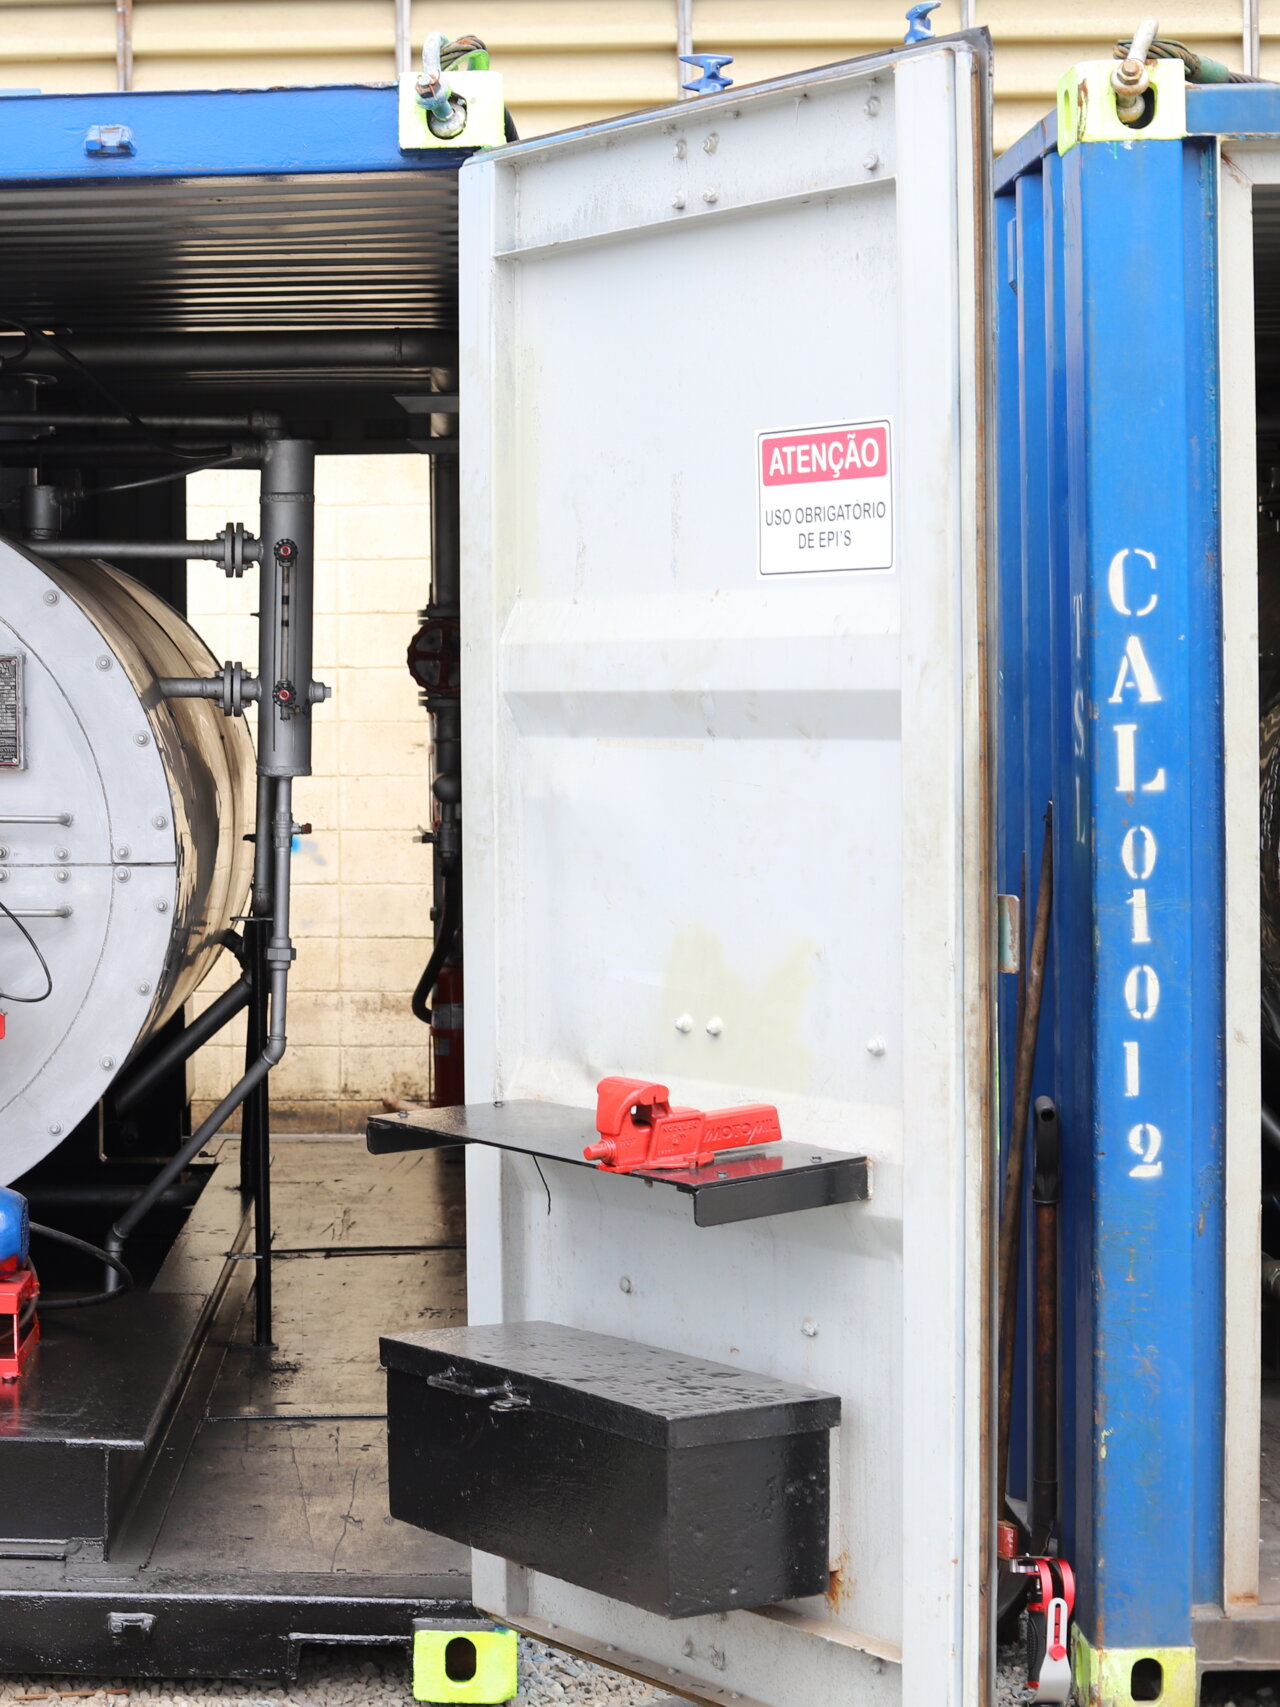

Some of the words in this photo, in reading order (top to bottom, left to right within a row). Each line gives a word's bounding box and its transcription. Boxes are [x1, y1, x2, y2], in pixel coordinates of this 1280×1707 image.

[769, 433, 879, 478] ATENÇÃO
[765, 508, 792, 526] USO
[798, 532, 815, 549] DE
